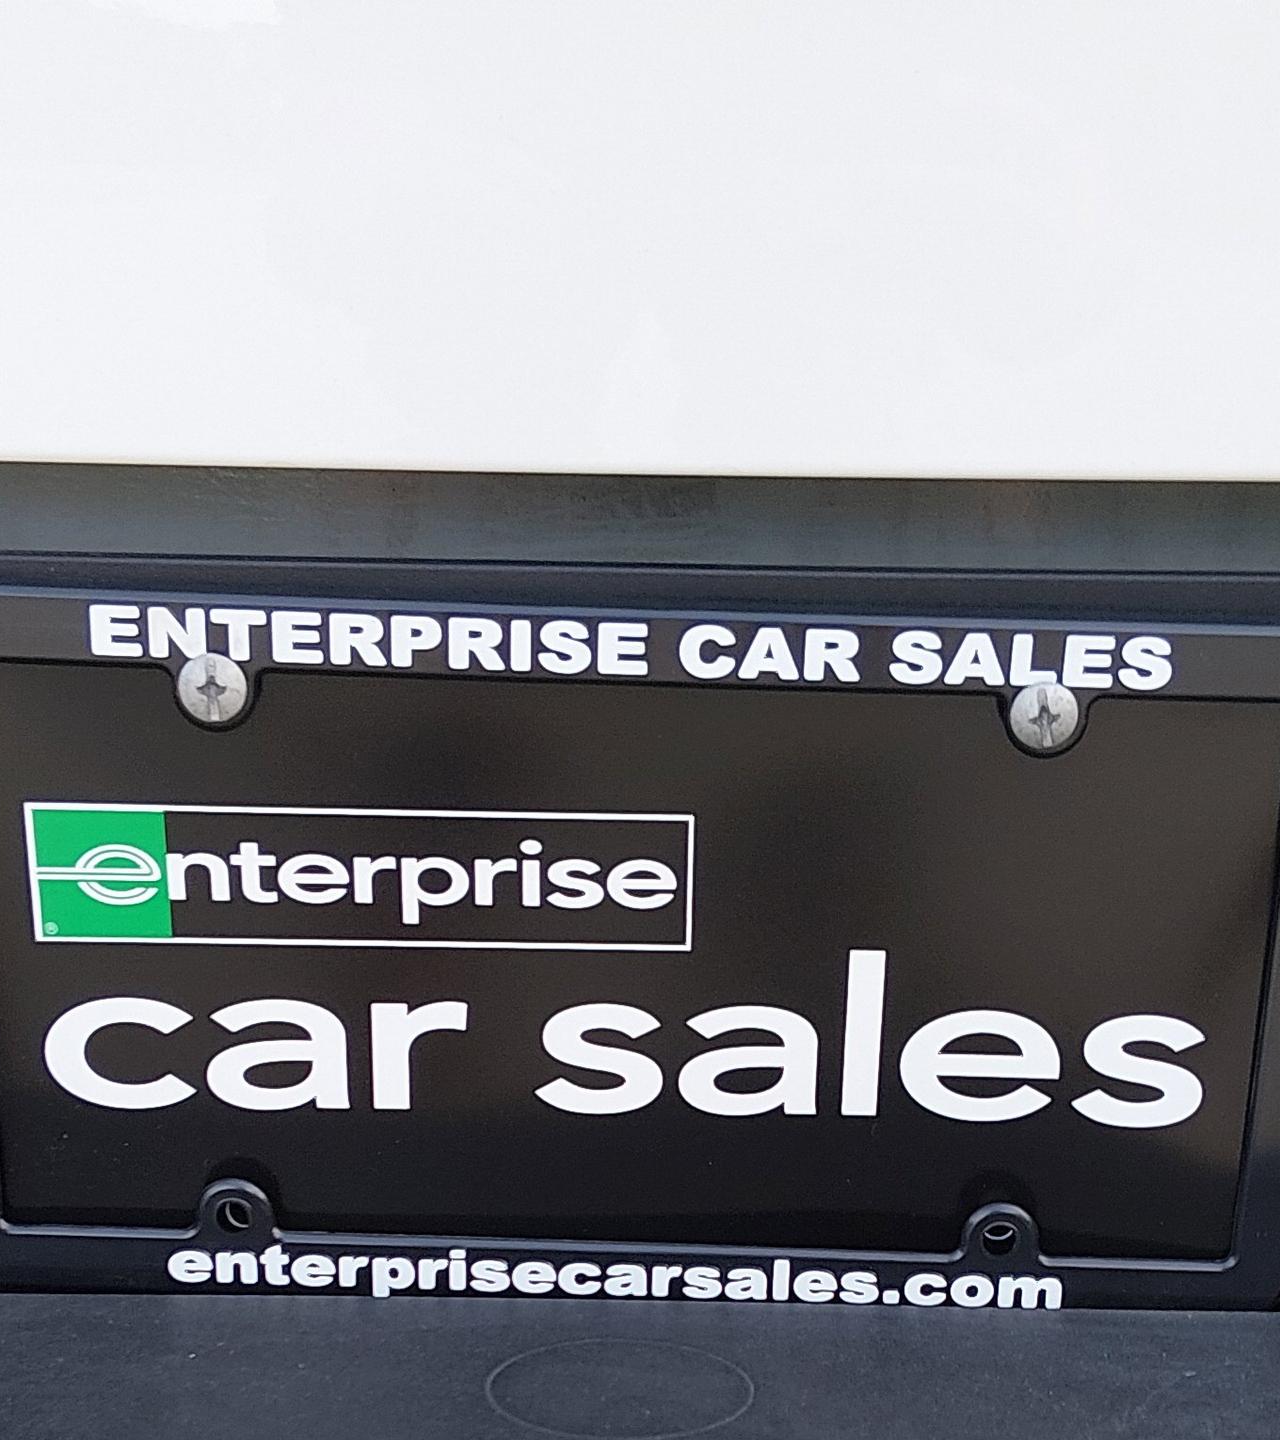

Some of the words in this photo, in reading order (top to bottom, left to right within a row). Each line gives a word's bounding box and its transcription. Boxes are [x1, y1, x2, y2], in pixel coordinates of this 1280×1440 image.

[88, 603, 649, 676] ENTERPRISE
[678, 624, 861, 682] CAR
[888, 630, 1173, 691] SALES
[75, 839, 678, 925] enterprise
[44, 997, 468, 1111] car
[534, 949, 1206, 1128] sales
[167, 1249, 1063, 1310] enterprisecarsales.com
